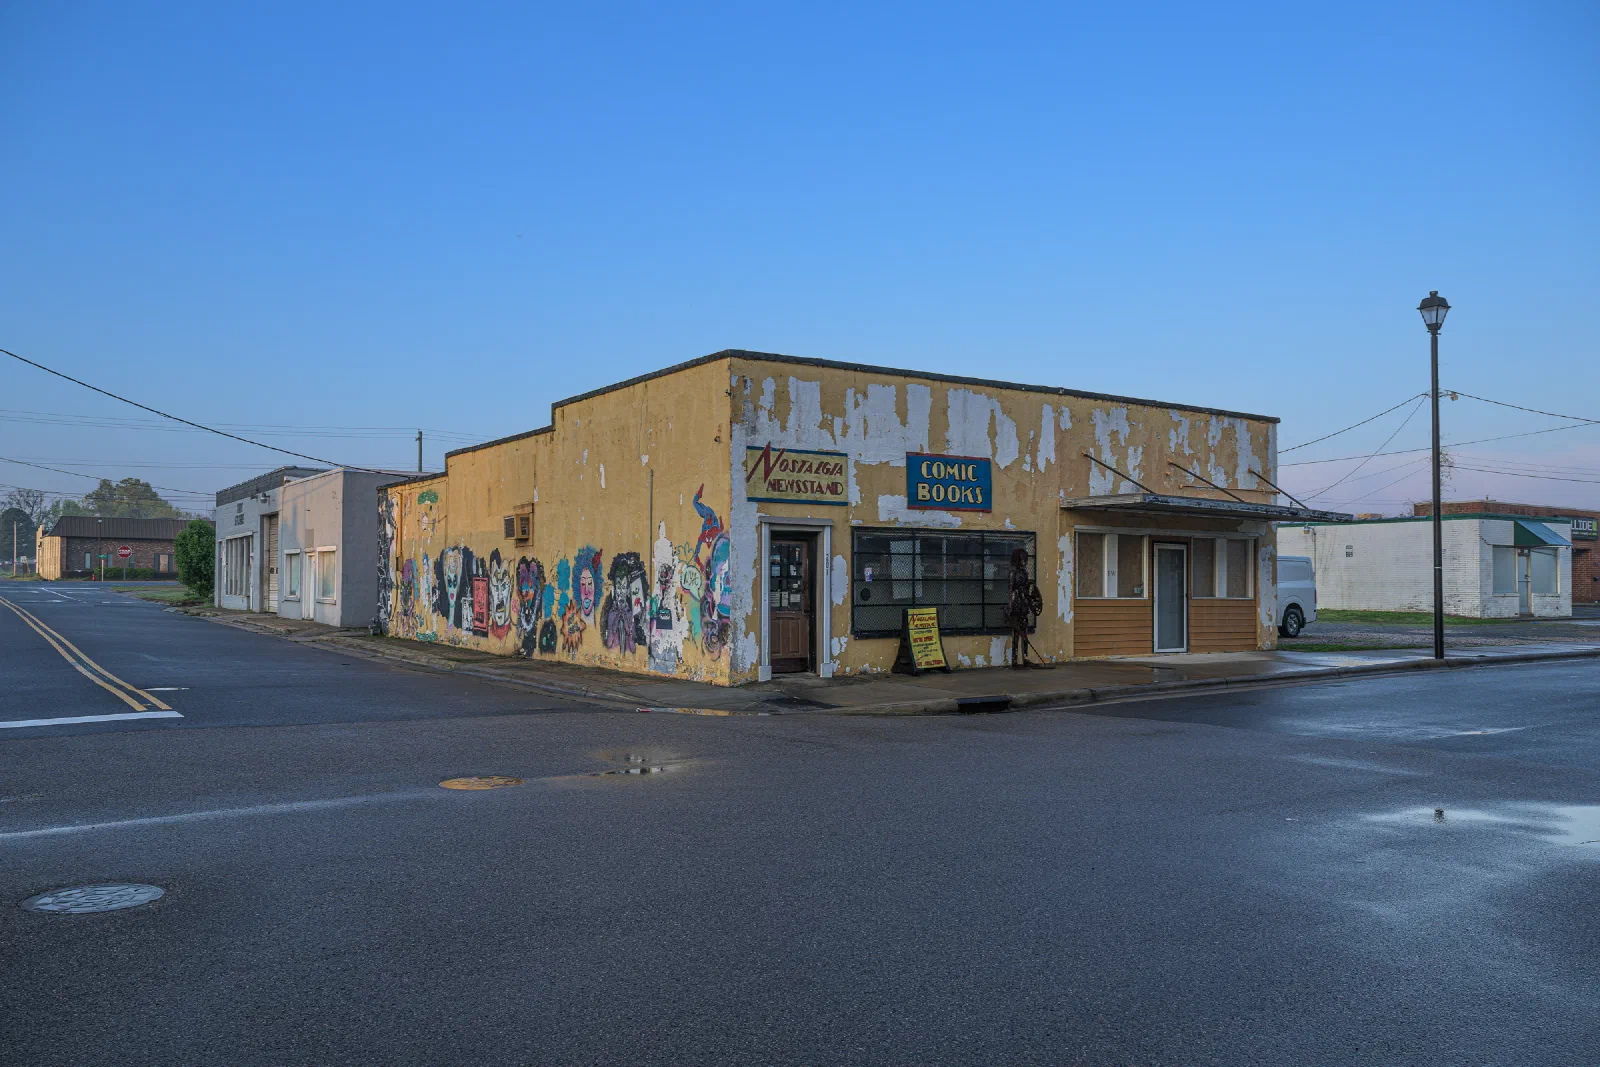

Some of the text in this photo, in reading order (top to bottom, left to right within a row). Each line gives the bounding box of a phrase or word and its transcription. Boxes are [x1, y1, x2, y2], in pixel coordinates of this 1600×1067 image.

[745, 441, 843, 483] NOSTALGIA
[921, 461, 978, 482] COMIC
[766, 478, 844, 495] NEWSSTAND
[917, 483, 983, 504] BOOKS
